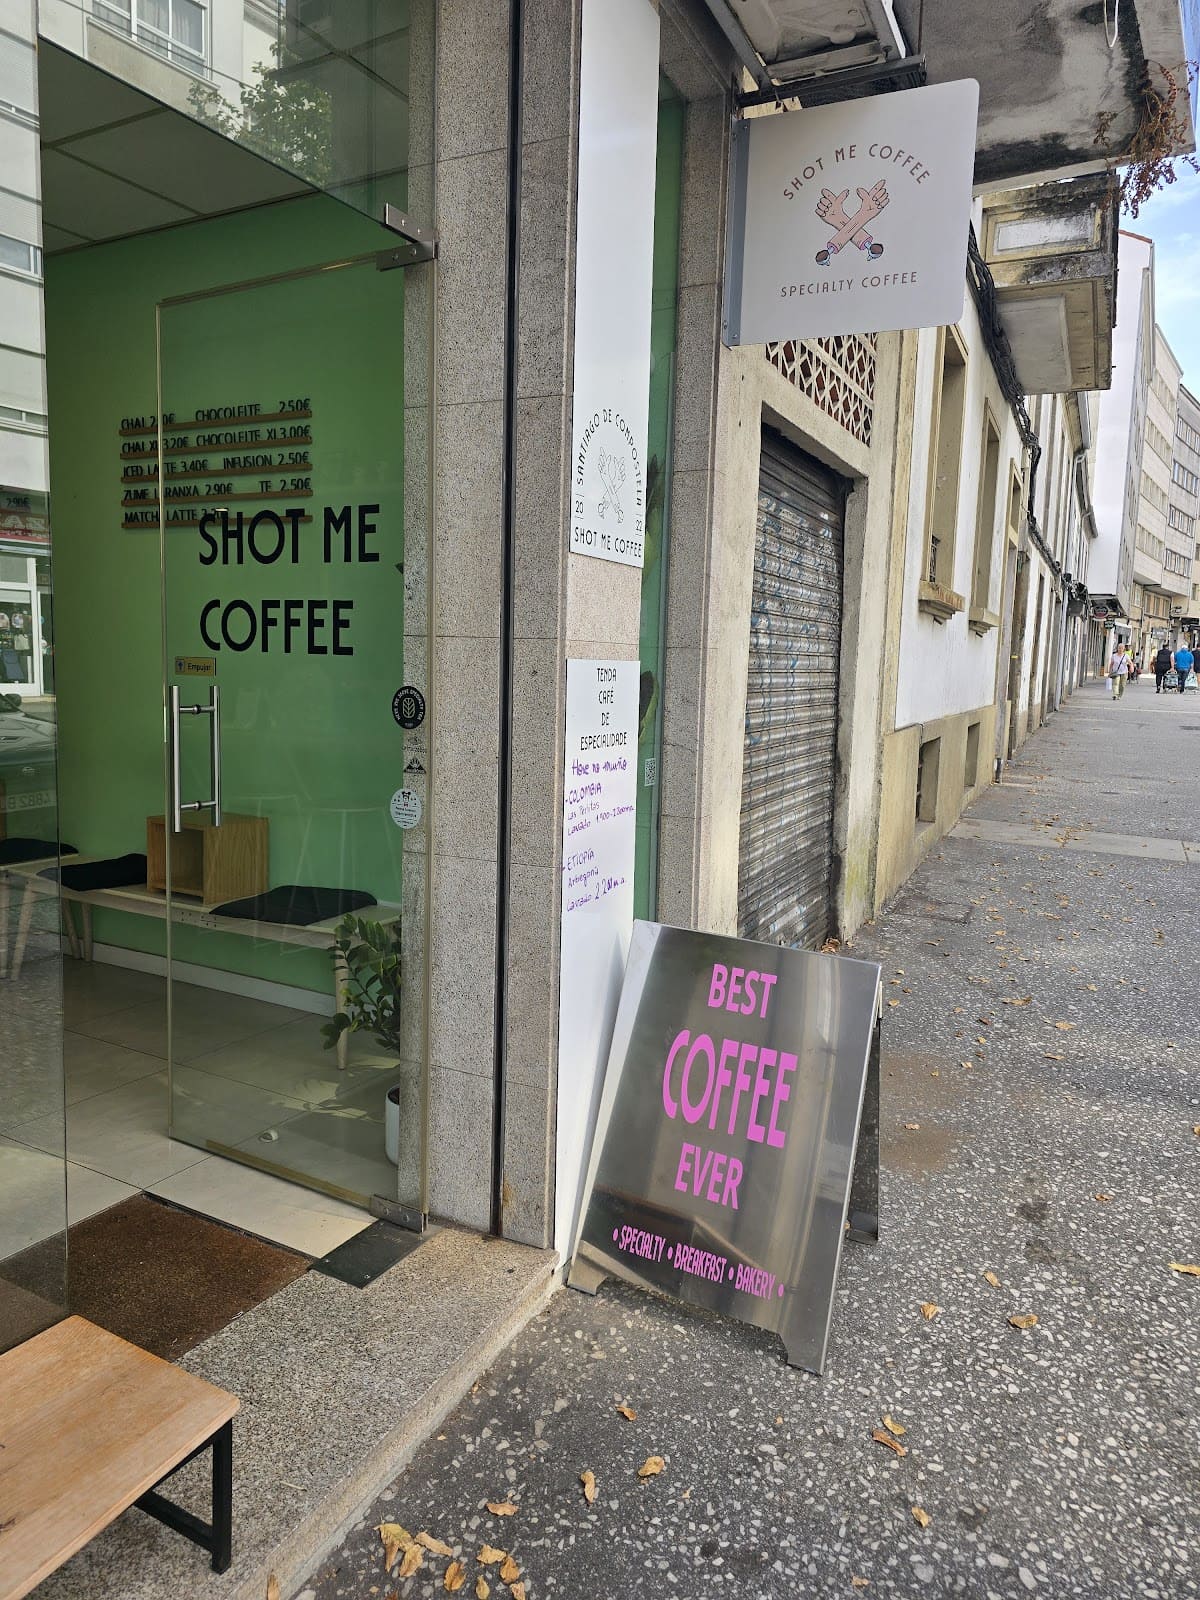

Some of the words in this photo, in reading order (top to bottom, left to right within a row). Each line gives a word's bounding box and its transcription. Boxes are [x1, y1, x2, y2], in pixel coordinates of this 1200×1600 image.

[783, 157, 825, 200] SHOT
[835, 145, 857, 163] ME
[868, 143, 930, 184] COFFEE
[780, 279, 855, 298] SPECIALTY
[861, 271, 918, 288] COFFEE
[195, 403, 261, 422] CHOCOLEITE
[196, 429, 261, 447] CHOCOLEITE
[576, 413, 600, 486] SANTIAGO
[602, 409, 612, 423] DE
[223, 454, 273, 470] INFUSION
[277, 451, 310, 466] 2.50€
[123, 465, 144, 478] ICED
[123, 488, 149, 501] ZUME
[259, 480, 272, 493] TE
[279, 477, 311, 492] 2.50€
[165, 508, 197, 522] LATTE
[575, 500, 584, 514] 20
[199, 505, 306, 565] SHOT
[323, 503, 381, 564] ME
[574, 526, 597, 547] SHOT
[601, 533, 611, 551] ME
[614, 537, 642, 558] COFFEE
[199, 598, 355, 657] COFFEE
[596, 668, 618, 682] TENDA
[598, 686, 615, 704] CAFÉ
[601, 712, 610, 726] DE
[580, 732, 628, 751] ESPECIALIDADE
[708, 963, 778, 1018] BEST
[662, 1029, 798, 1149] COFFEE
[674, 1142, 744, 1210] EVER
[618, 1224, 666, 1263] SPECIALTY
[673, 1243, 728, 1284] BREAKFAST
[735, 1263, 777, 1300] BAKERY
